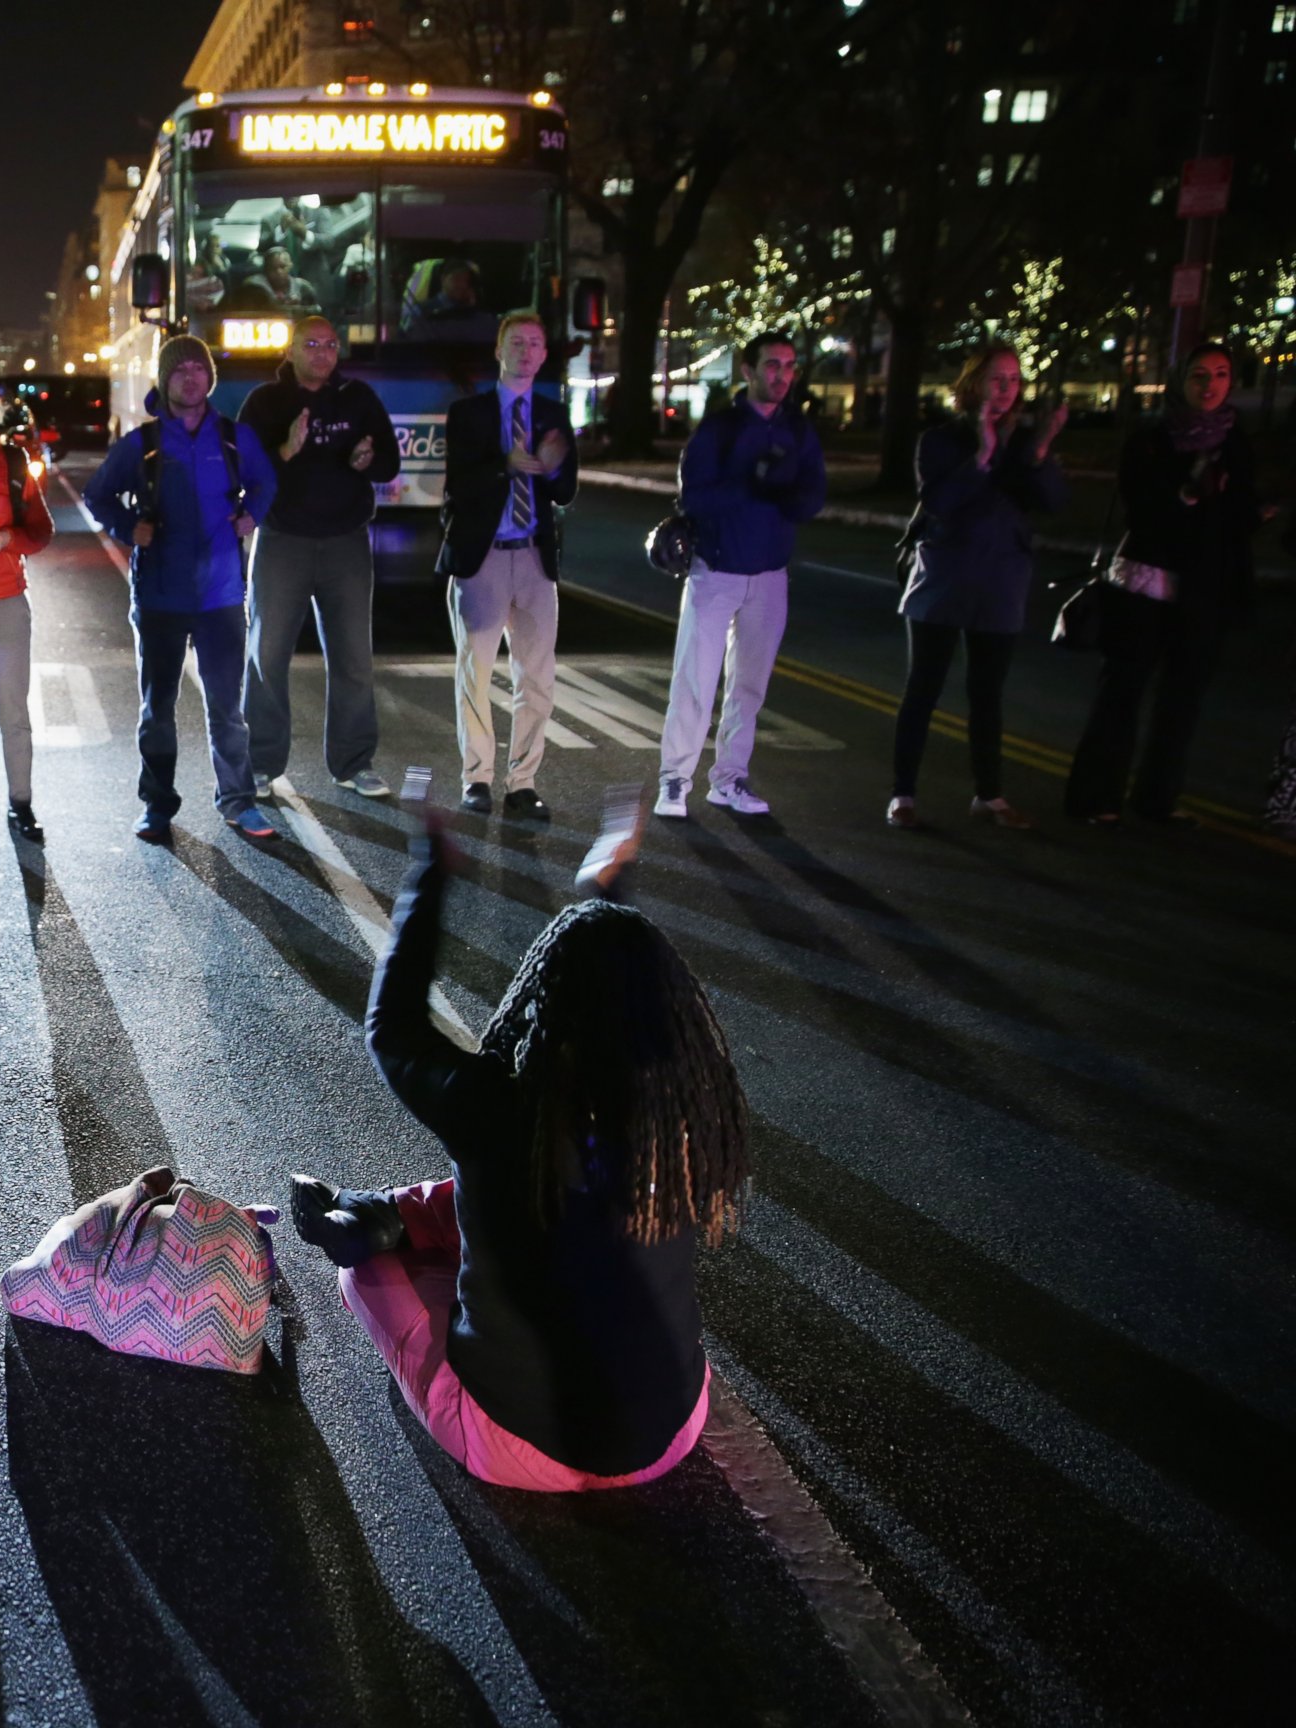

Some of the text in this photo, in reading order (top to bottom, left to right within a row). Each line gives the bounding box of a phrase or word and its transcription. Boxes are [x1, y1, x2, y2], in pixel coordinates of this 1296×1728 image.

[181, 128, 214, 152] 347
[242, 114, 506, 151] LINDENDALE VIA PRTC
[539, 130, 565, 150] 347
